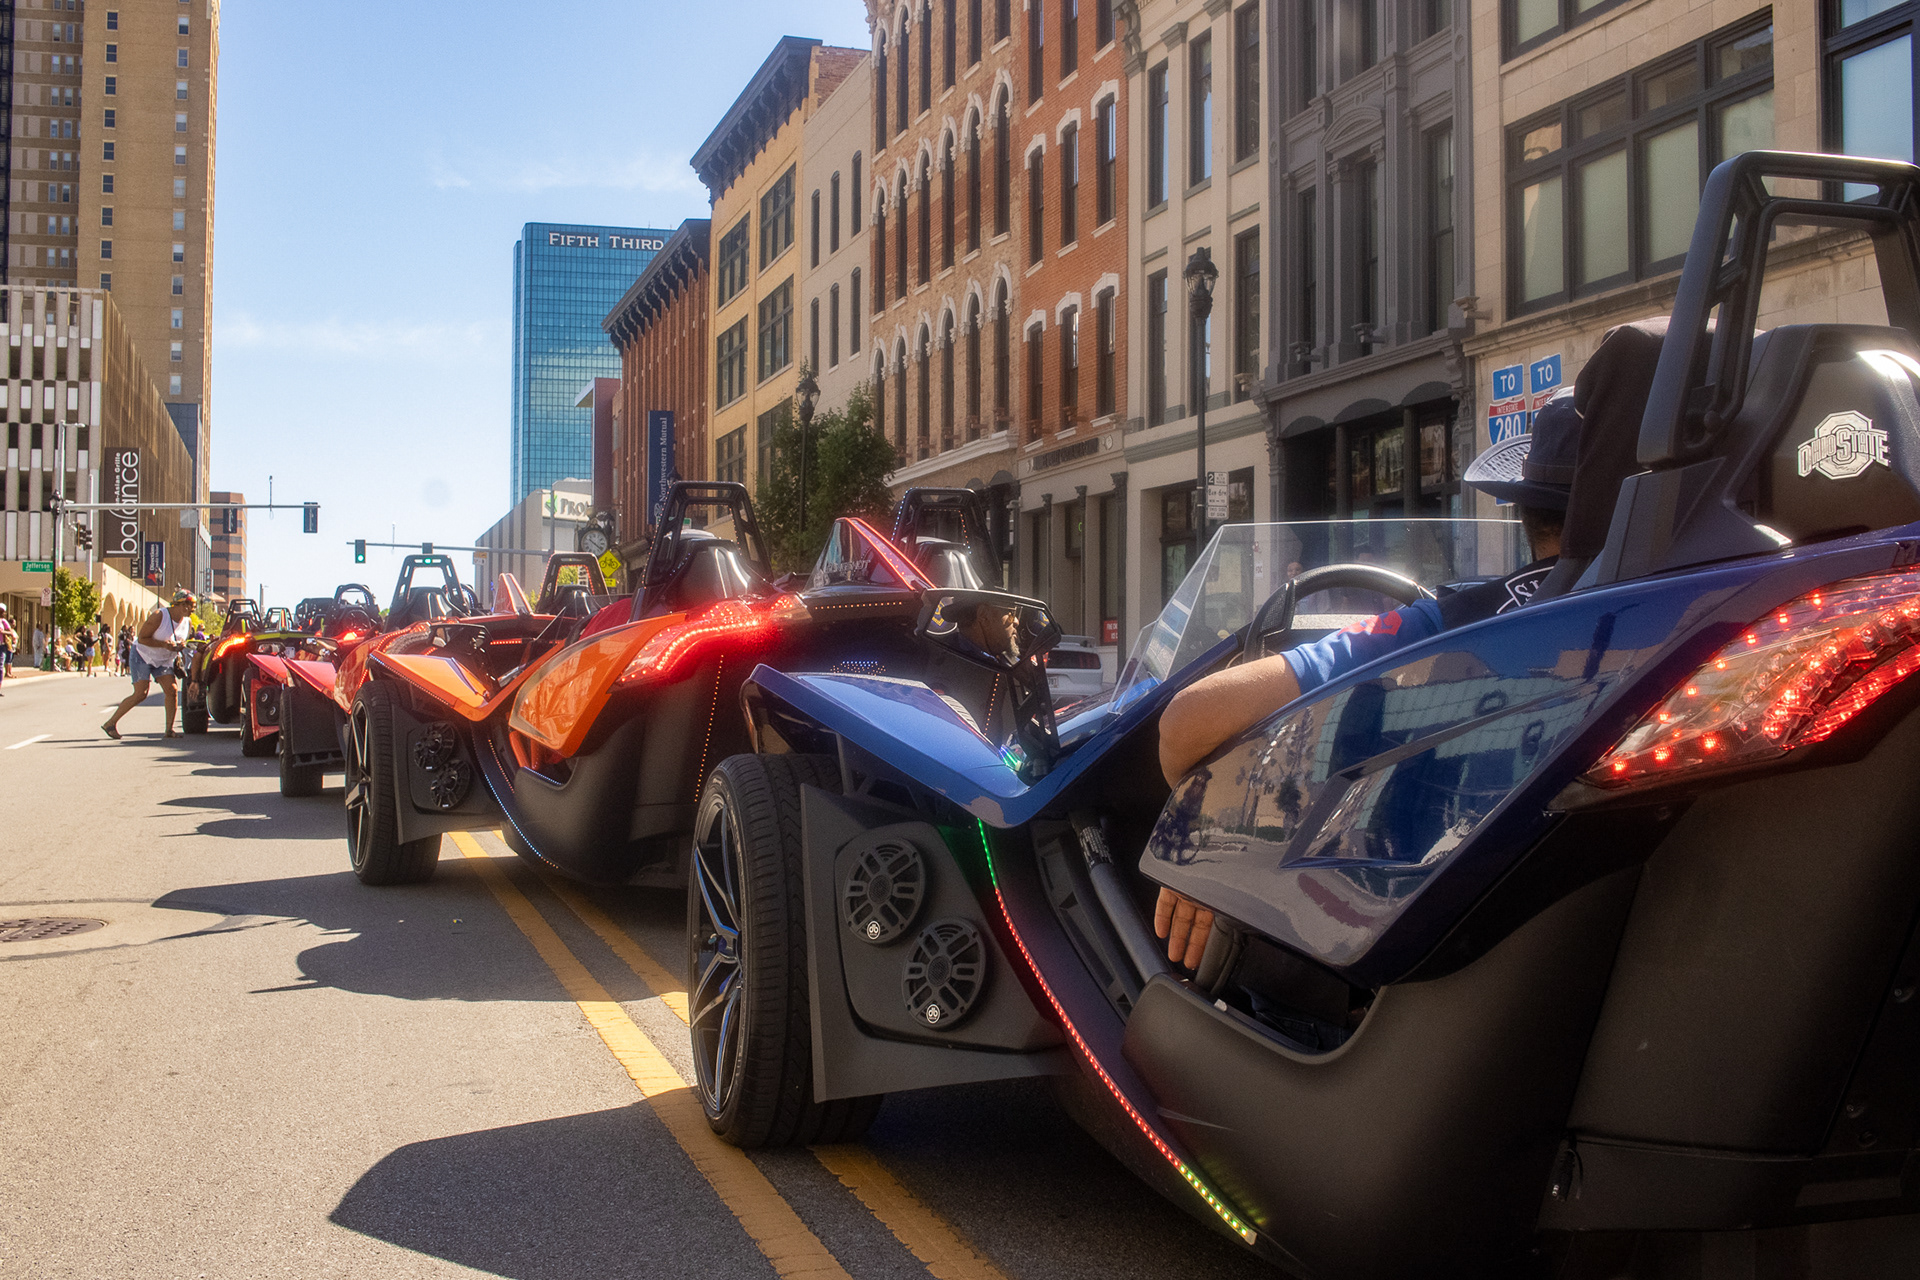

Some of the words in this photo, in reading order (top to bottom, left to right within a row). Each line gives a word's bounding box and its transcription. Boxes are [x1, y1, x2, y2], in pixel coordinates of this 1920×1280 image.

[549, 232, 599, 247] FIFTH
[609, 235, 664, 250] THIRD
[1500, 373, 1515, 392] TO
[1537, 364, 1553, 385] TO
[1496, 401, 1519, 414] INTERSTATE
[1495, 413, 1521, 444] 280
[1836, 428, 1889, 467] STATE
[659, 447, 667, 502] Northwestern
[1208, 473, 1214, 483] 2
